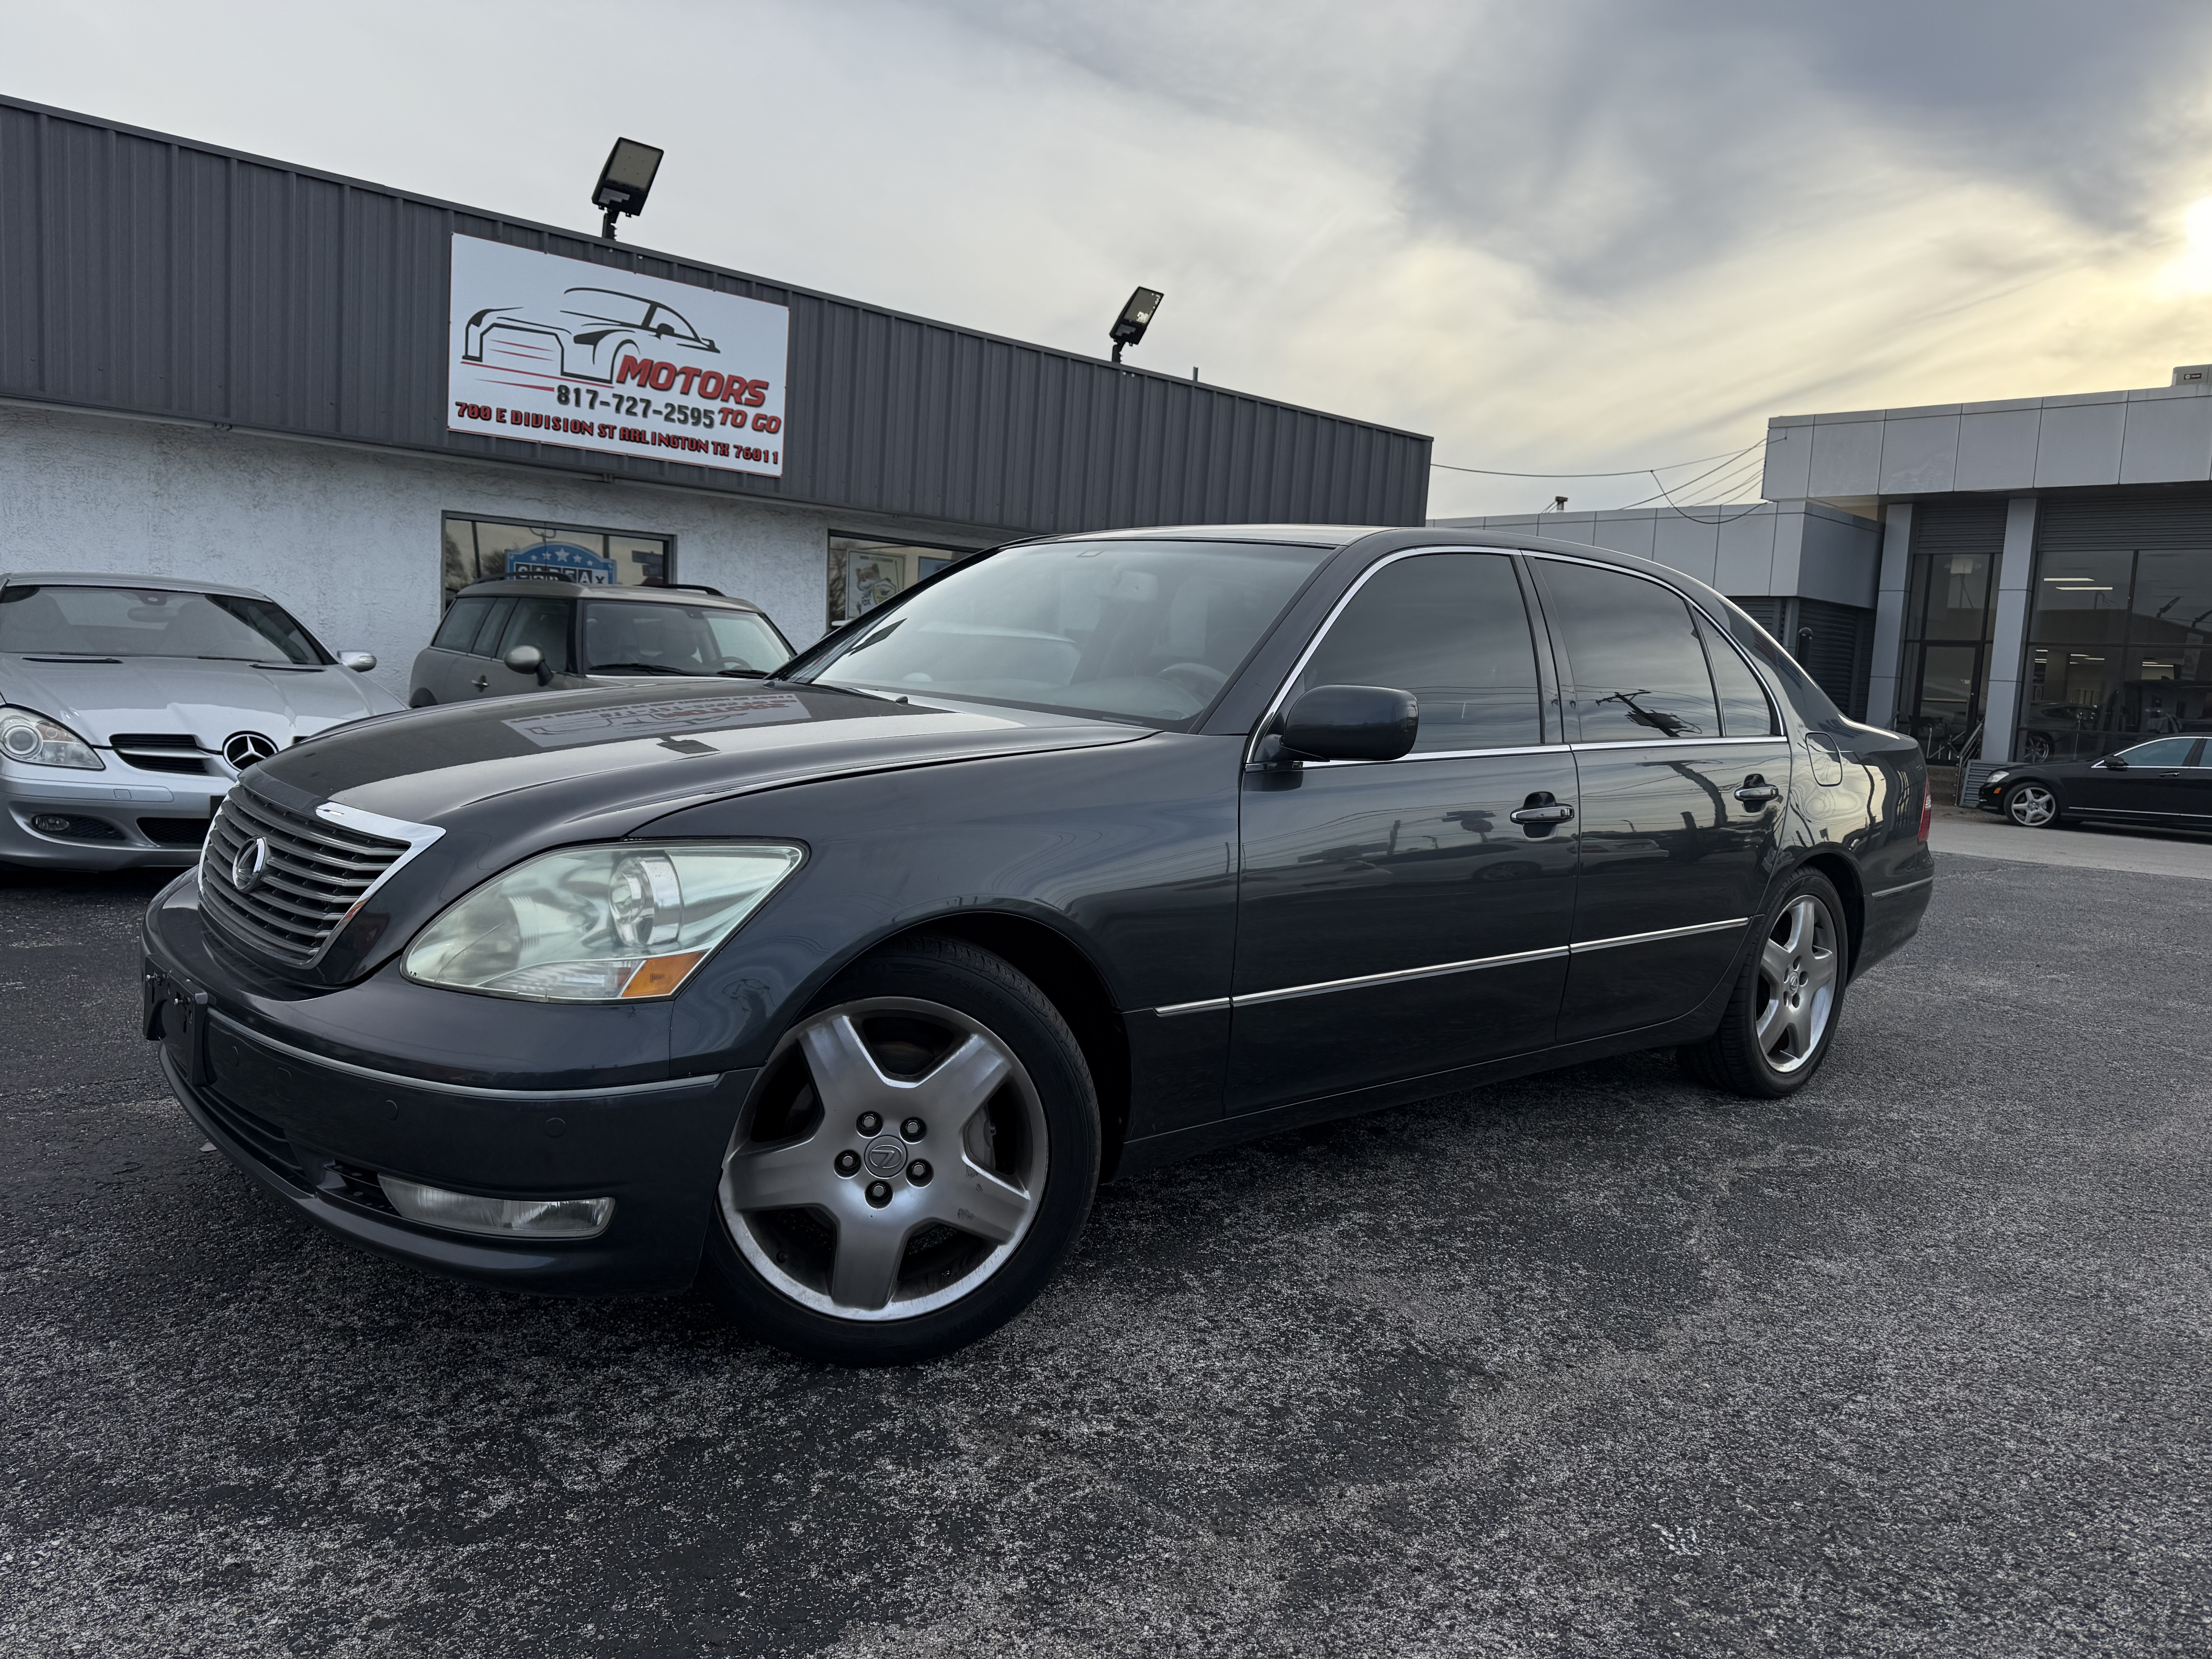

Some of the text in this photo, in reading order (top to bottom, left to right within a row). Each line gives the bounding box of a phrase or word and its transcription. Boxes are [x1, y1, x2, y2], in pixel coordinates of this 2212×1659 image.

[616, 354, 769, 407] MOTORS
[556, 385, 715, 429] 817-727-2595
[718, 407, 781, 433] TO GO
[455, 401, 779, 464] 700 E DIVISION ST ARLINGTON TX 76011
